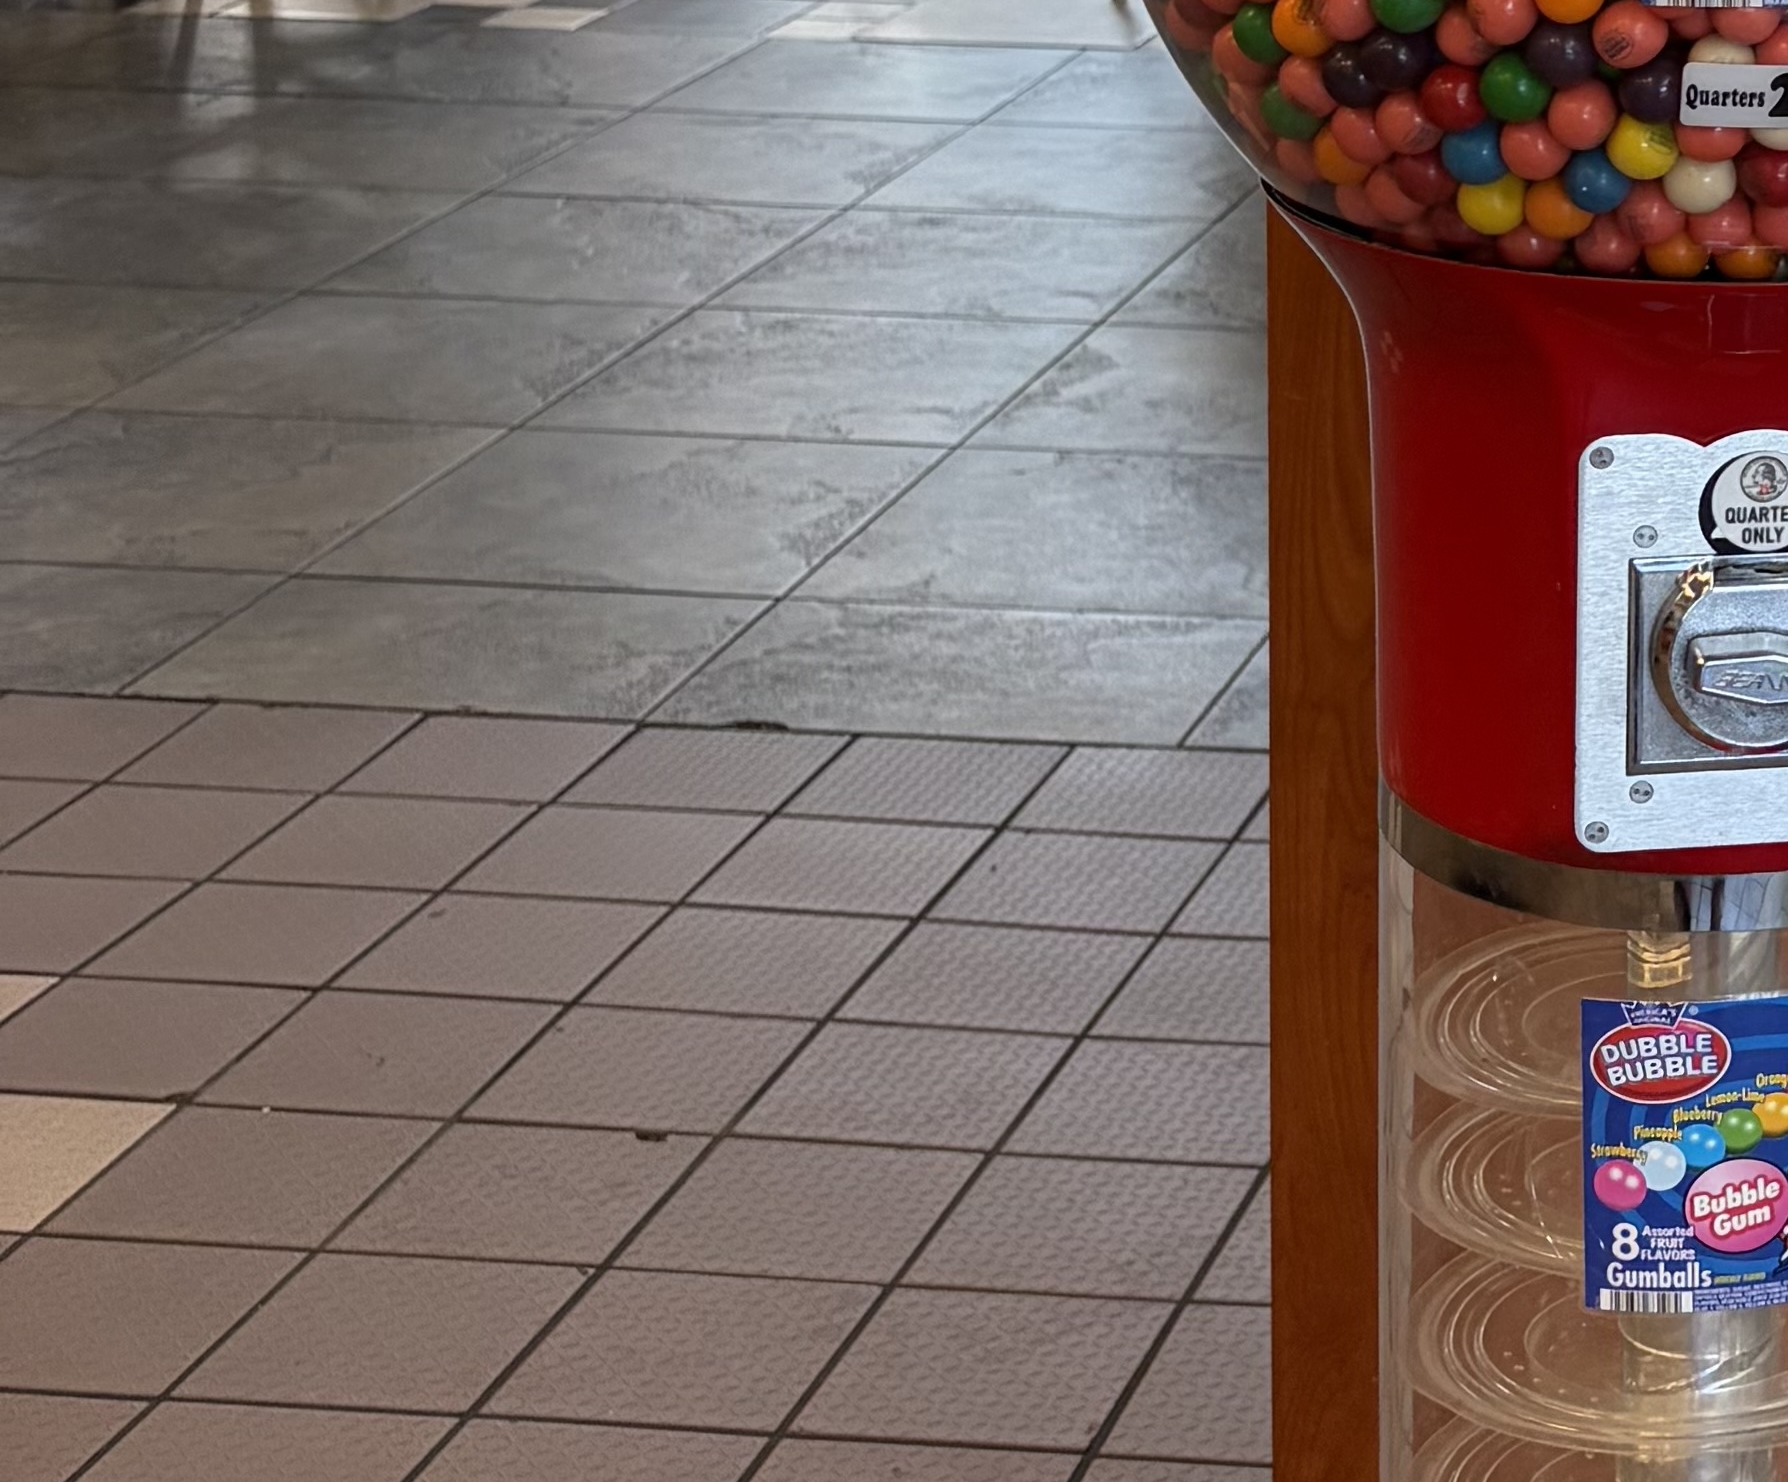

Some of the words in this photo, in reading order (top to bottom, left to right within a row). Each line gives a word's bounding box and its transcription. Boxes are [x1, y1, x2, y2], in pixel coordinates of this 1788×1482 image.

[1685, 83, 1766, 110] Quarters
[1741, 526, 1785, 546] ONLY
[1600, 1033, 1713, 1064] DUBBLE
[1606, 1055, 1718, 1087] BUBBLE
[1672, 1108, 1723, 1125] Blueberry
[1633, 1123, 1683, 1142] Pineapple
[1693, 1177, 1780, 1218] Bubble
[1641, 1224, 1694, 1237] Assorted
[1713, 1205, 1771, 1237] Gum
[1611, 1222, 1640, 1261] 8
[1640, 1249, 1696, 1261] FLAVORS
[1650, 1237, 1685, 1249] FRUIT
[1606, 1261, 1712, 1289] Gumballs
